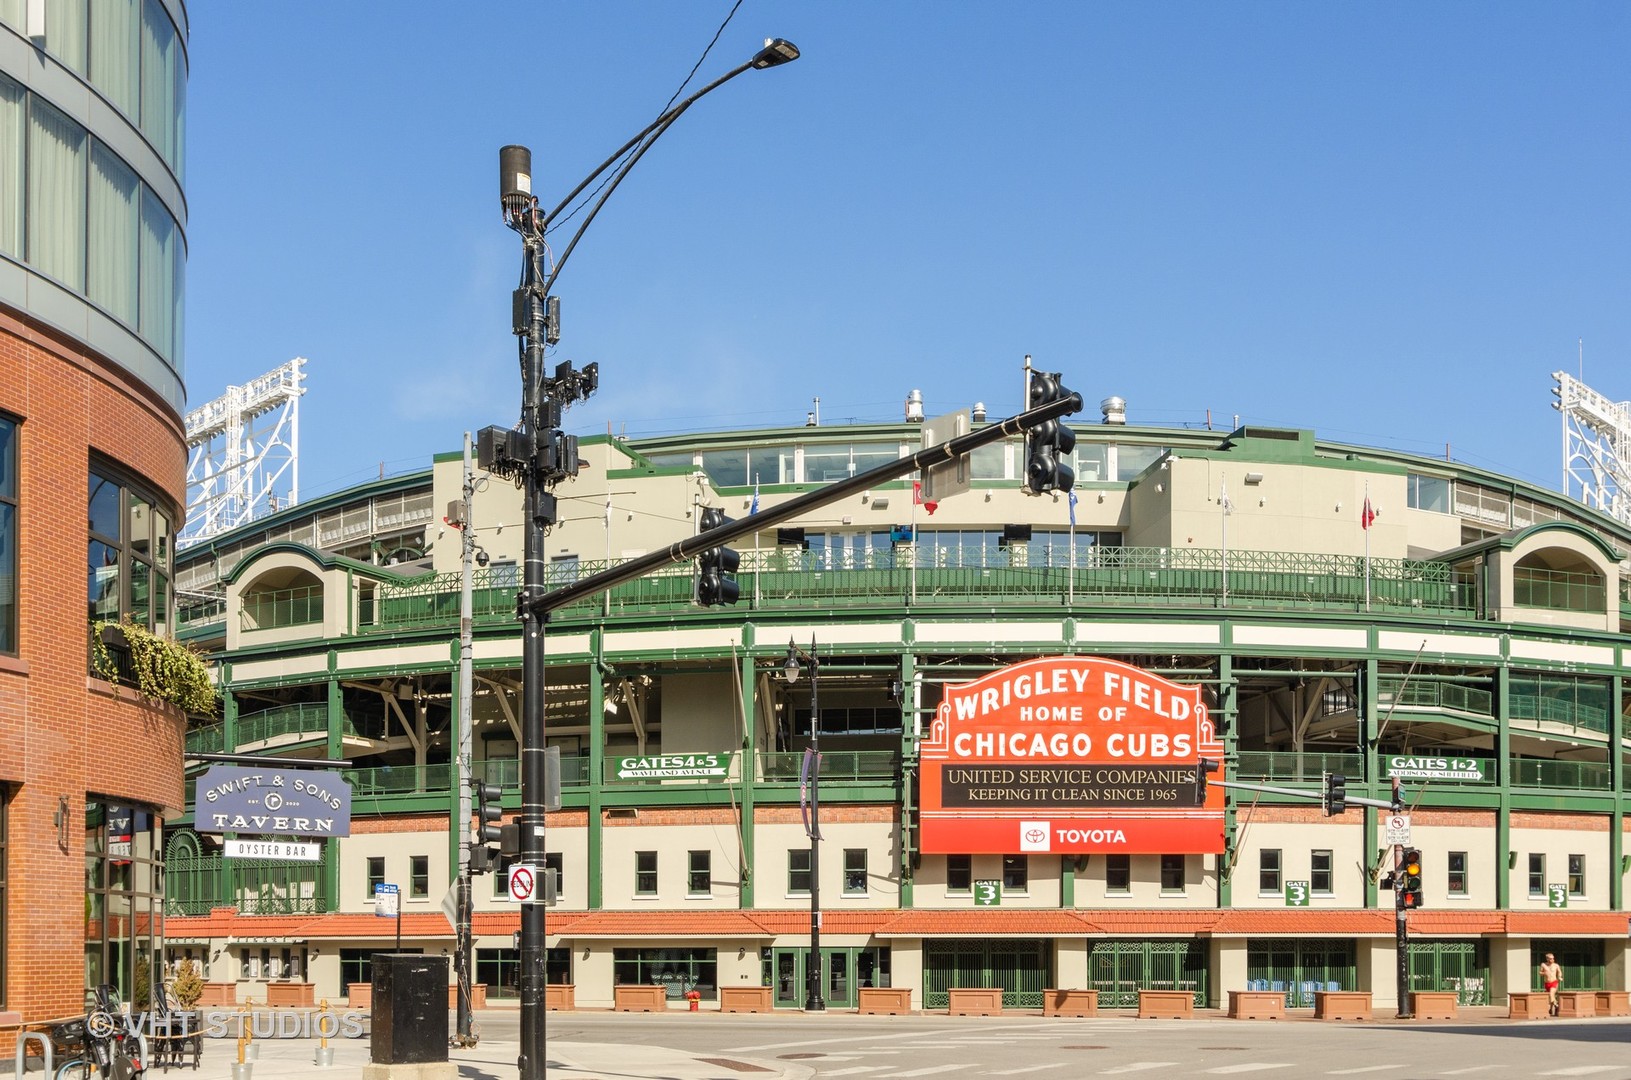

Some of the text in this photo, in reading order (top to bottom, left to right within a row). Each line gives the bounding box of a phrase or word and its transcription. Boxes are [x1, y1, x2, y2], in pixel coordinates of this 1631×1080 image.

[953, 668, 1191, 721] WRIGLEY FIELD
[1020, 706, 1128, 721] HOME OF
[953, 732, 1192, 758] CHICAGO CUBS
[621, 756, 684, 770] GATES
[1391, 757, 1478, 771] GATES 1&2
[948, 769, 1197, 784] UNITED SERVICE COMPANIES
[205, 774, 342, 810] SWIFT & SONS
[968, 788, 1178, 800] KEEPING IT CLEAN SINCE 1965
[212, 813, 334, 832] TAVERN
[1056, 829, 1127, 844] TOYOTA
[238, 843, 307, 857] OYSTER BAR
[979, 885, 996, 901] 3
[1290, 886, 1306, 901] 3
[1551, 889, 1565, 903] 3
